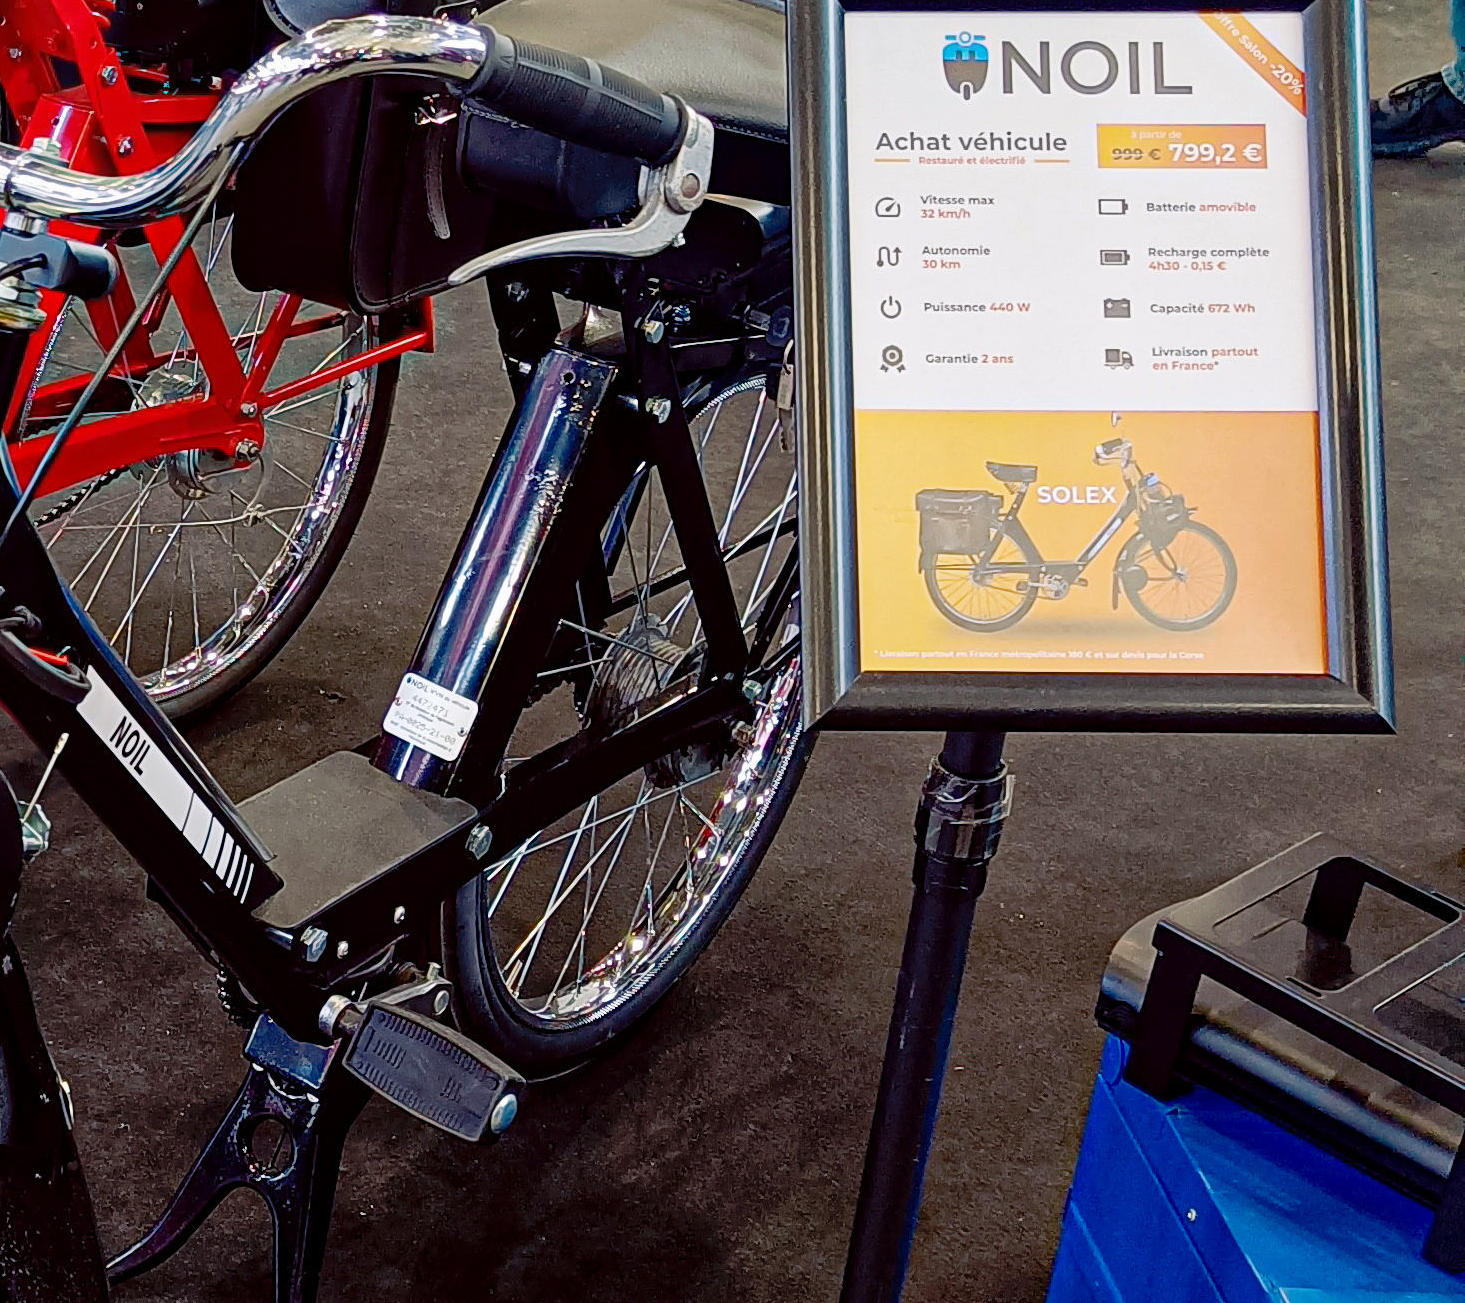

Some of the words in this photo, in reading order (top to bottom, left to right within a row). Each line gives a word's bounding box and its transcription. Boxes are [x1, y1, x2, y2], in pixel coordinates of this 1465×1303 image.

[1001, 40, 1193, 96] NOIL
[1239, 34, 1269, 65] Salon
[1270, 63, 1304, 96] -20%
[875, 131, 951, 152] Achat
[957, 130, 1068, 152] véhicule
[1139, 130, 1167, 141] partir
[1168, 130, 1183, 140] de
[918, 155, 965, 166] Restauré
[968, 156, 979, 165] et
[981, 155, 1027, 166] électrifié
[1168, 143, 1237, 166] 799,2
[1242, 144, 1263, 163] €
[920, 194, 964, 206] Vitesse
[967, 196, 995, 206] max
[1146, 201, 1197, 213] Batterie
[1199, 201, 1257, 213] amovible
[920, 208, 936, 220] 32
[938, 207, 972, 221] km/h
[921, 245, 991, 257] Autonomie
[1148, 247, 1207, 260] Recharge
[1210, 245, 1270, 260] complète
[921, 258, 936, 270] 30
[938, 258, 961, 270] km
[1148, 260, 1180, 272] 4h30
[1190, 260, 1216, 273] 0,15
[1217, 260, 1227, 272] €
[923, 301, 987, 313] Puissance
[989, 301, 1013, 313] 440
[1015, 301, 1031, 313] W
[1149, 301, 1205, 315] Capacité
[1208, 302, 1230, 314] 672
[1233, 302, 1256, 314] Wh
[925, 353, 979, 365] Garantie
[981, 353, 989, 365] 2
[991, 354, 1014, 365] ans
[1151, 346, 1208, 358] Livraison
[1210, 346, 1259, 360] partout
[1152, 362, 1169, 371] en
[1036, 485, 1117, 505] SOLEX
[411, 678, 429, 694] NOIL
[109, 715, 151, 777] NOIL
